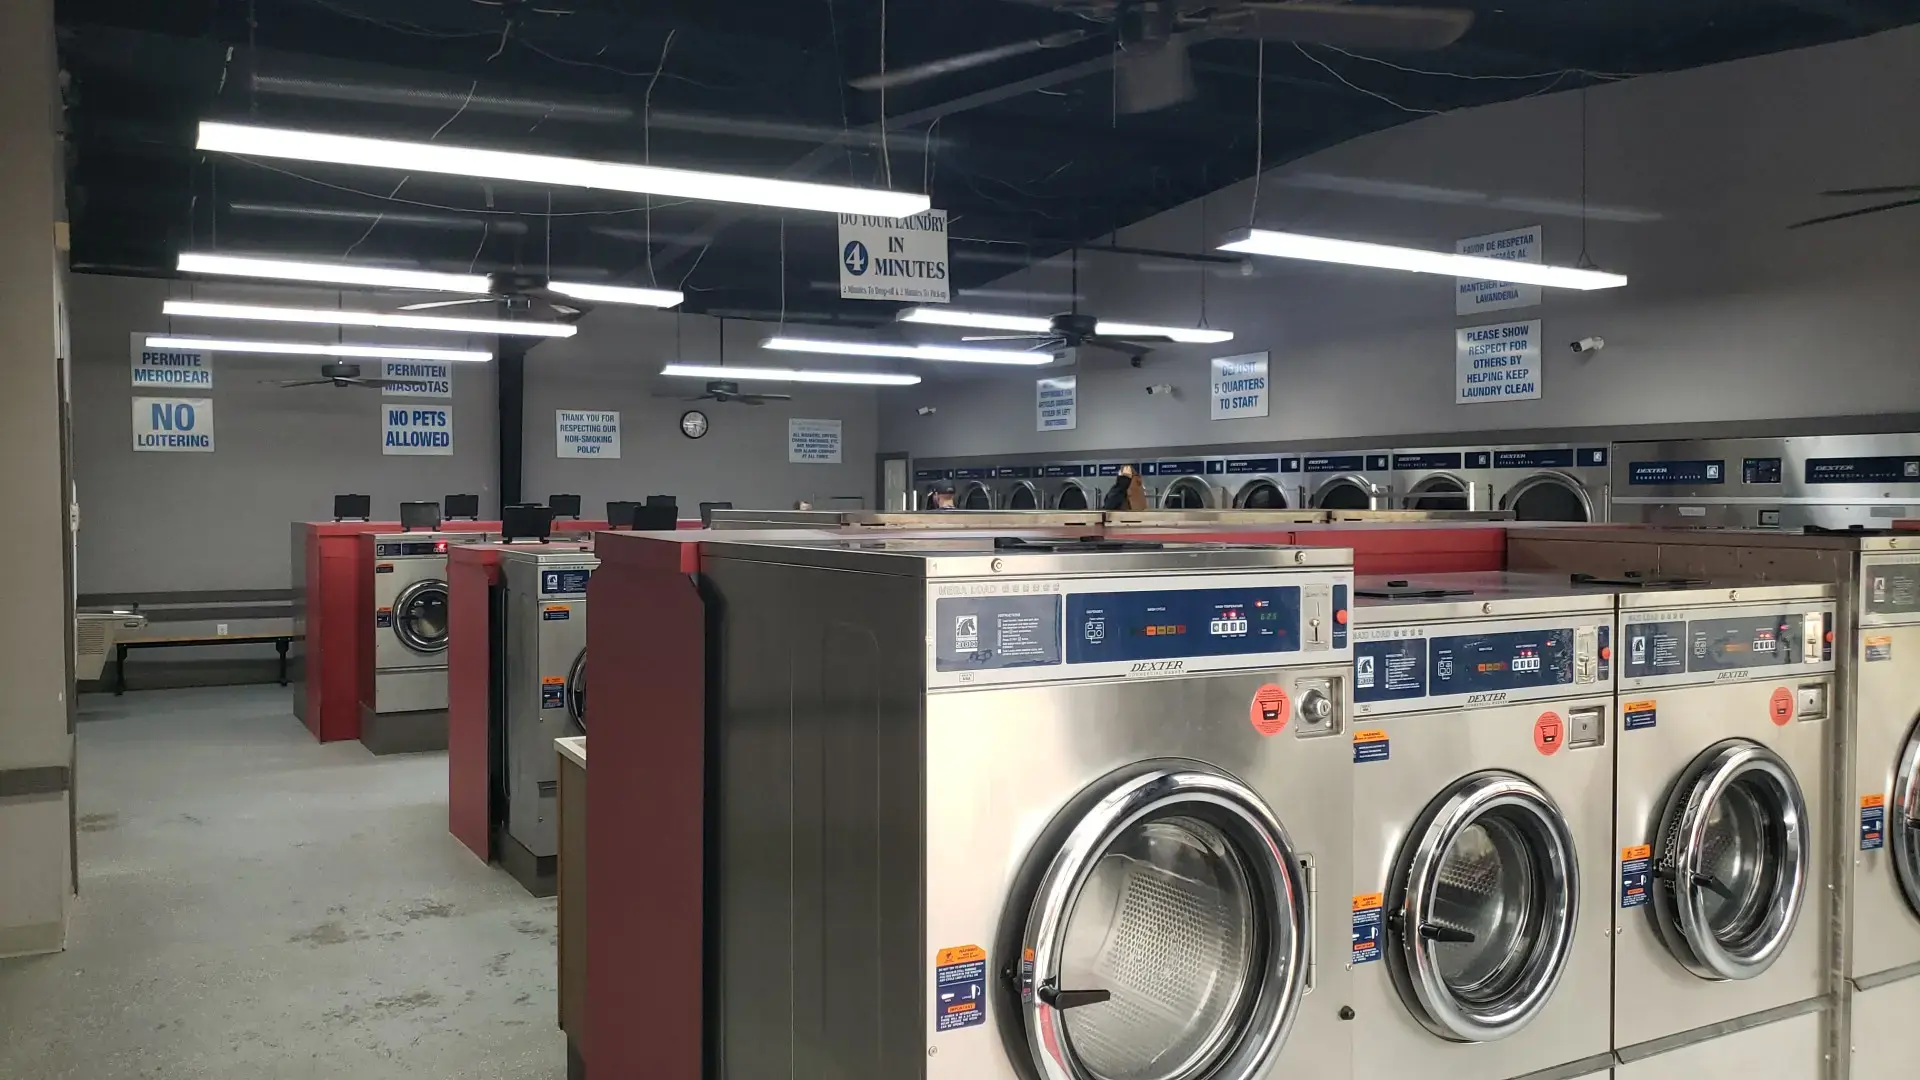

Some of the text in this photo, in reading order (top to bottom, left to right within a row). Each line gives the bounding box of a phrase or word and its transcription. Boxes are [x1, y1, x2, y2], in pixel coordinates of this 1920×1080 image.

[861, 215, 892, 229] YOUR
[895, 215, 946, 233] LAUNDRY
[1486, 242, 1496, 251] DE
[1497, 234, 1534, 249] RESPETAR
[845, 236, 905, 271] 4 IN
[874, 257, 946, 280] MINUTES
[1467, 325, 1529, 341] PLEASE SHOW
[1469, 340, 1528, 356] RESPECT FOR
[142, 352, 202, 367] PERMITE
[1473, 355, 1522, 369] OTHERS BY
[134, 368, 209, 384] MERODEAR
[387, 363, 447, 378] PERMITEN
[1466, 369, 1529, 383] HELPING KEEP
[385, 381, 449, 393] MASCOTAS
[1214, 377, 1265, 394] 5 QUARTERS
[1462, 382, 1535, 398] LAUNDRY CLEAN
[1220, 395, 1259, 410] TO START
[151, 403, 195, 431] NO
[389, 410, 447, 427] NO PETS
[561, 413, 615, 422] THANK YOU FOR
[560, 424, 617, 433] RESPECTING OUR
[137, 434, 209, 448] LOITERING
[385, 431, 450, 447] ALLOWED
[564, 435, 613, 444] NON-SMOKING
[577, 445, 601, 454] POLICY
[1130, 660, 1184, 673] DEXTER
[1717, 670, 1749, 680] DEXTER
[1467, 692, 1507, 704] DEXTER
